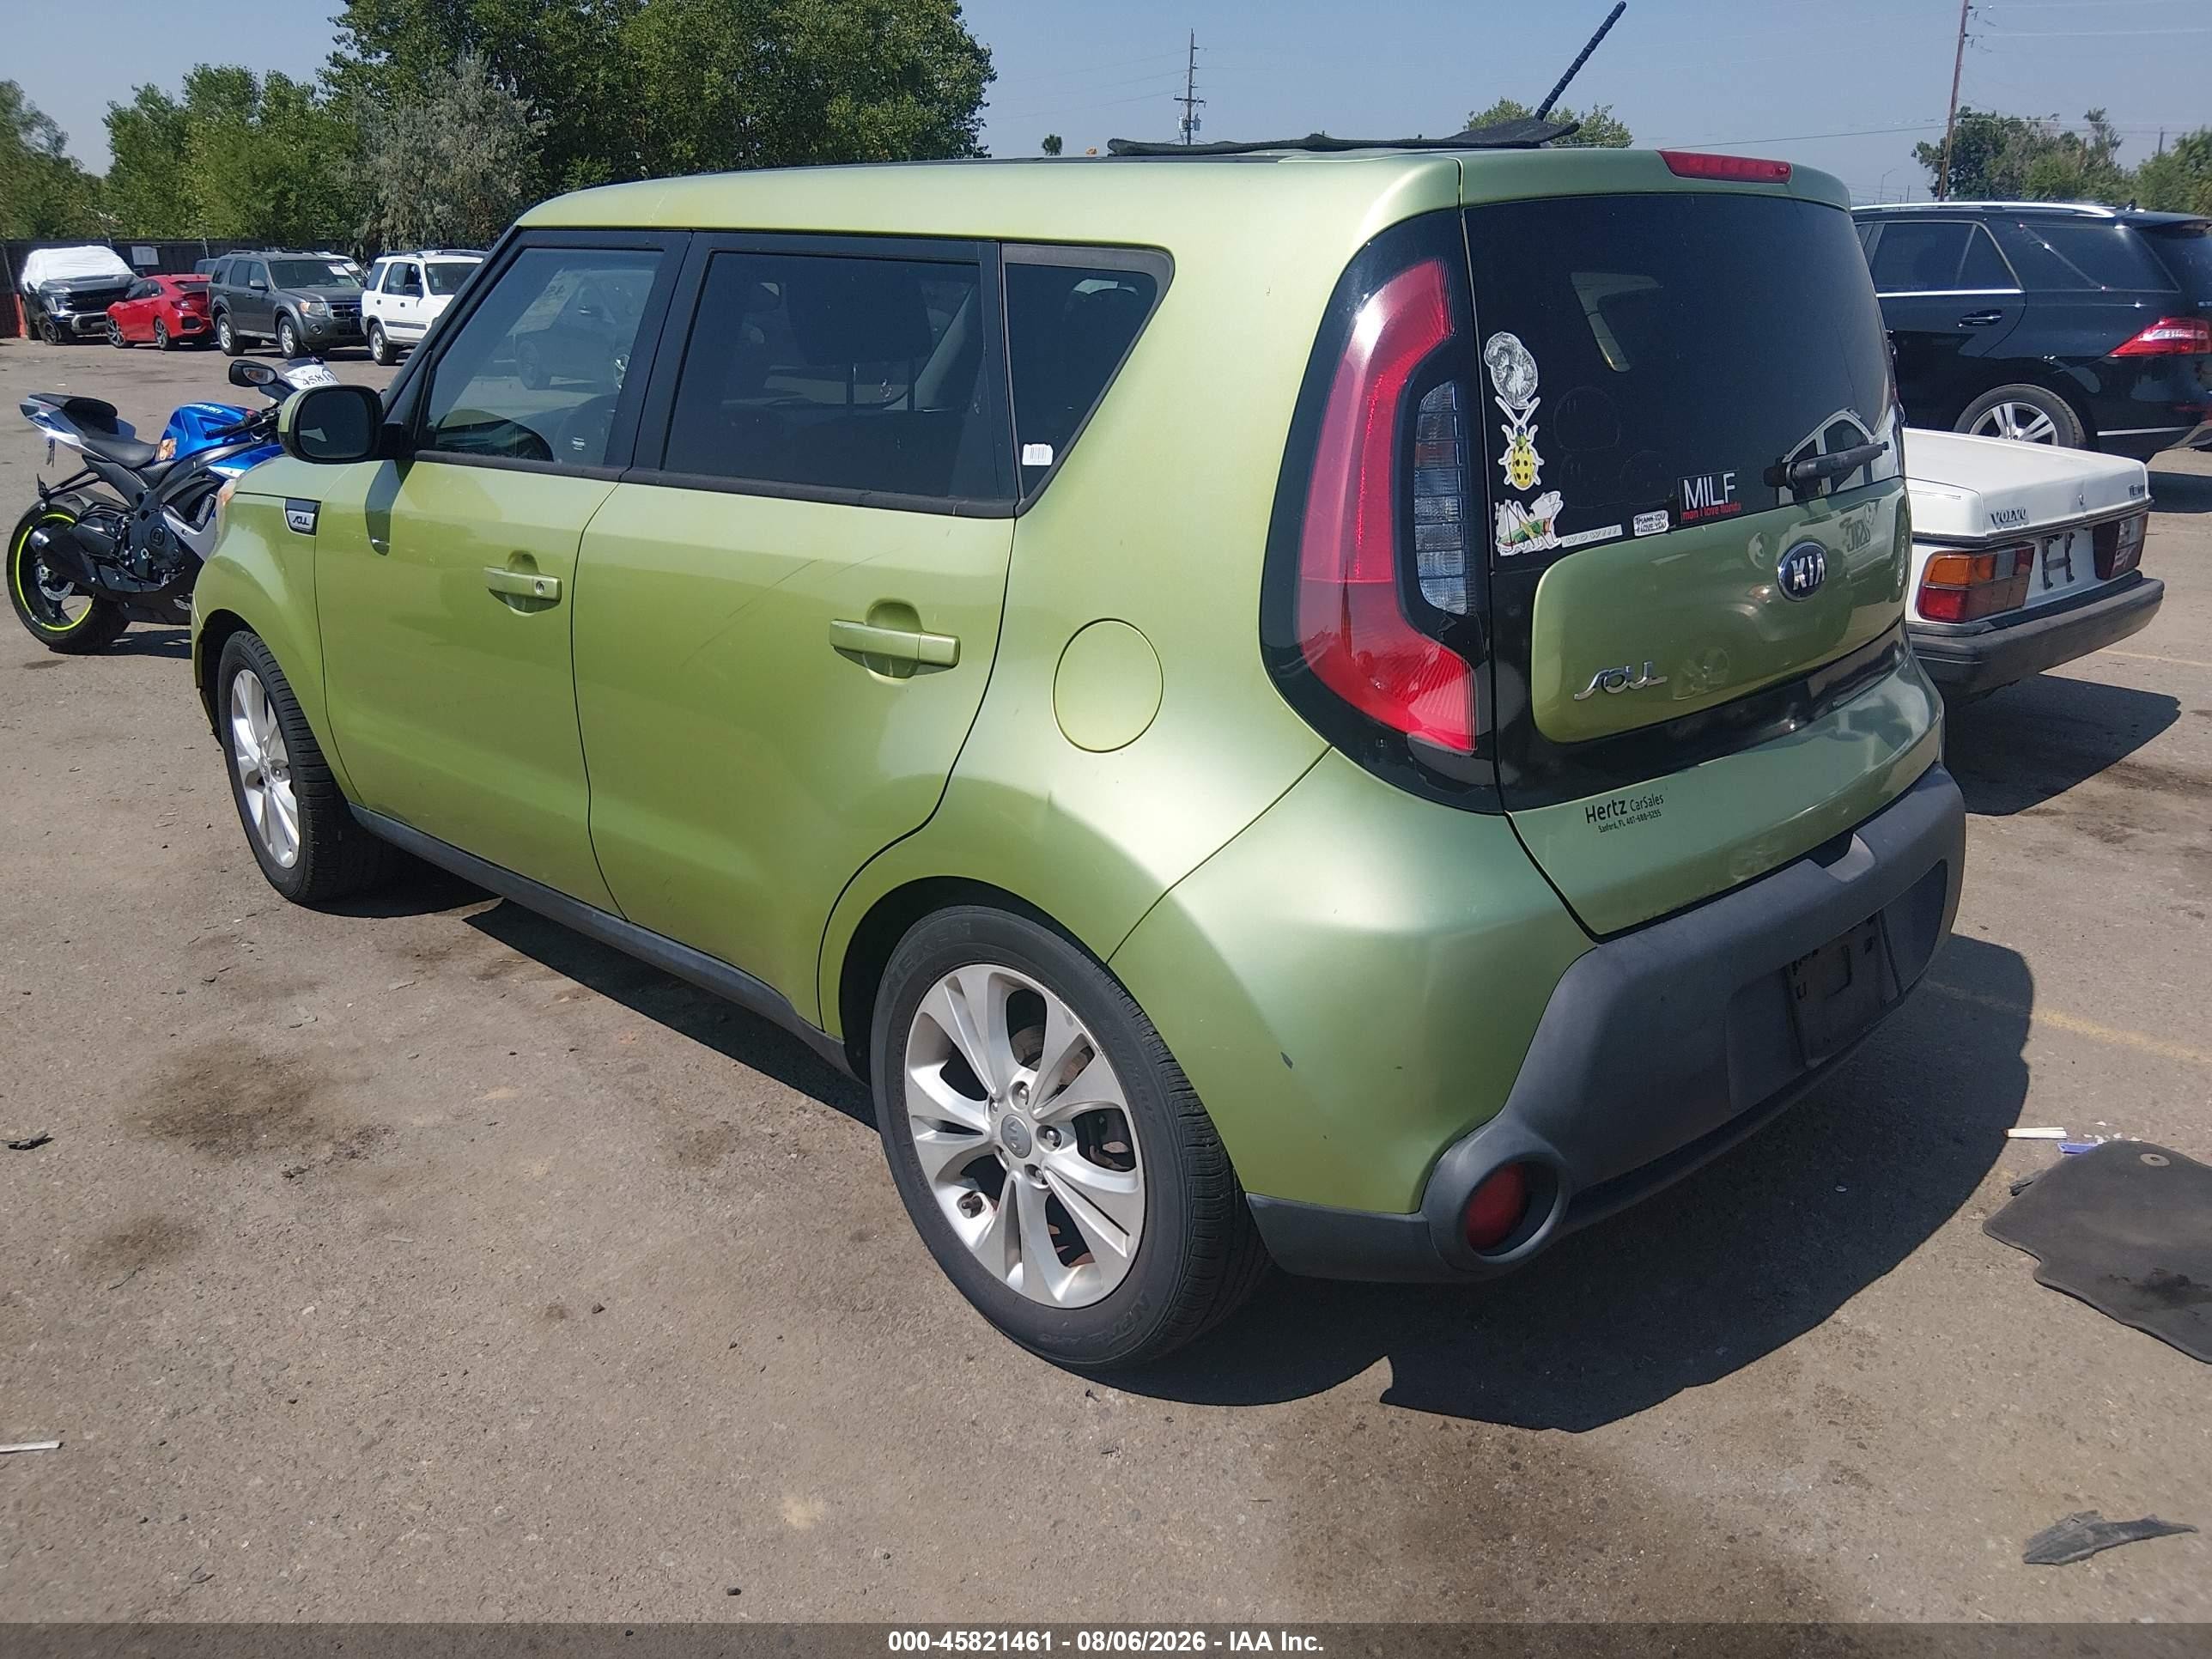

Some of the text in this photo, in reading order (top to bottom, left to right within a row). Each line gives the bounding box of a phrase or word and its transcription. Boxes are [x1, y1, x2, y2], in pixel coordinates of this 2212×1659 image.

[1683, 472, 1735, 510] MILF
[1635, 512, 1666, 525] THANK YOU
[1682, 510, 1698, 520] man
[1704, 505, 1719, 516] love
[1990, 507, 2027, 526] VOLVO
[1655, 520, 1667, 530] YOU
[1790, 552, 1826, 591] KIA
[1585, 793, 1664, 823] Hertz CarSales
